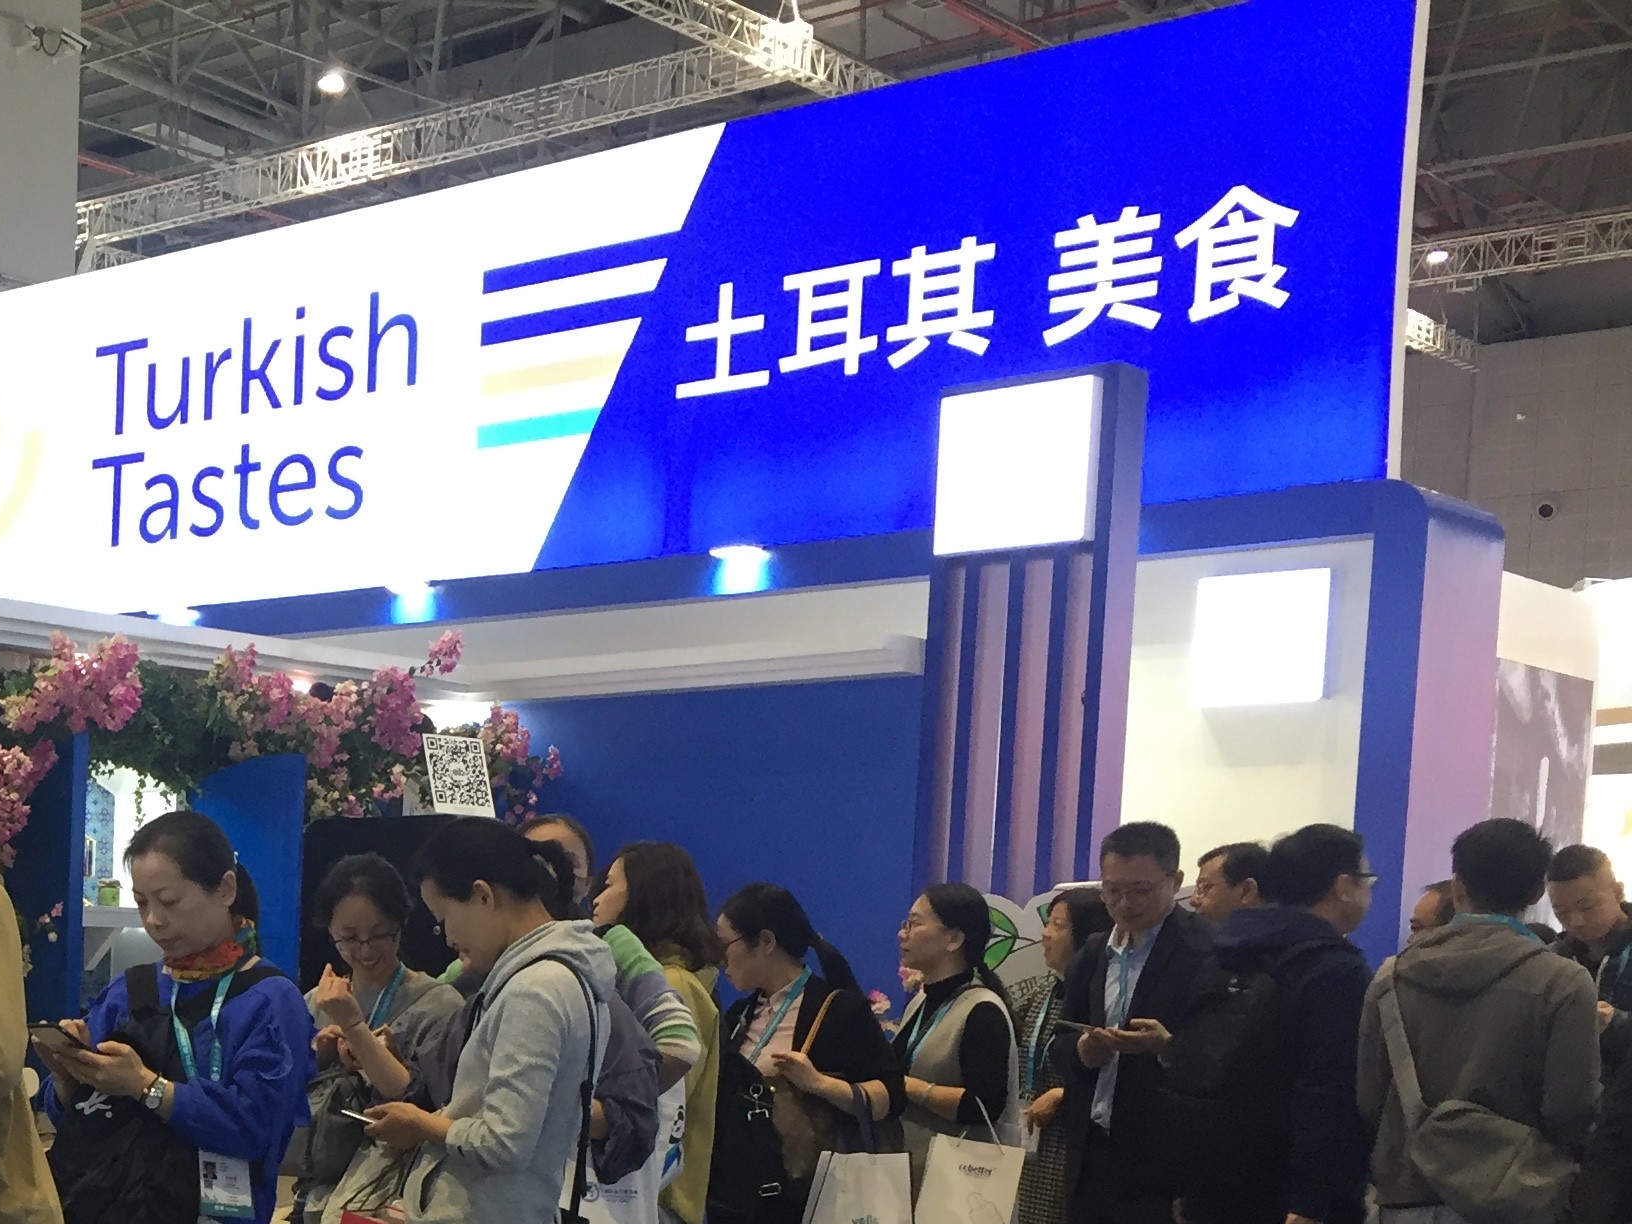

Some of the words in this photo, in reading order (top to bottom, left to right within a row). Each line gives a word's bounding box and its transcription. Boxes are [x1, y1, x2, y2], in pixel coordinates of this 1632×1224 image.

[95, 290, 419, 438] Turkish
[675, 235, 997, 400] 土耳其
[1042, 185, 1300, 347] 美食
[91, 444, 364, 549] Tastes
